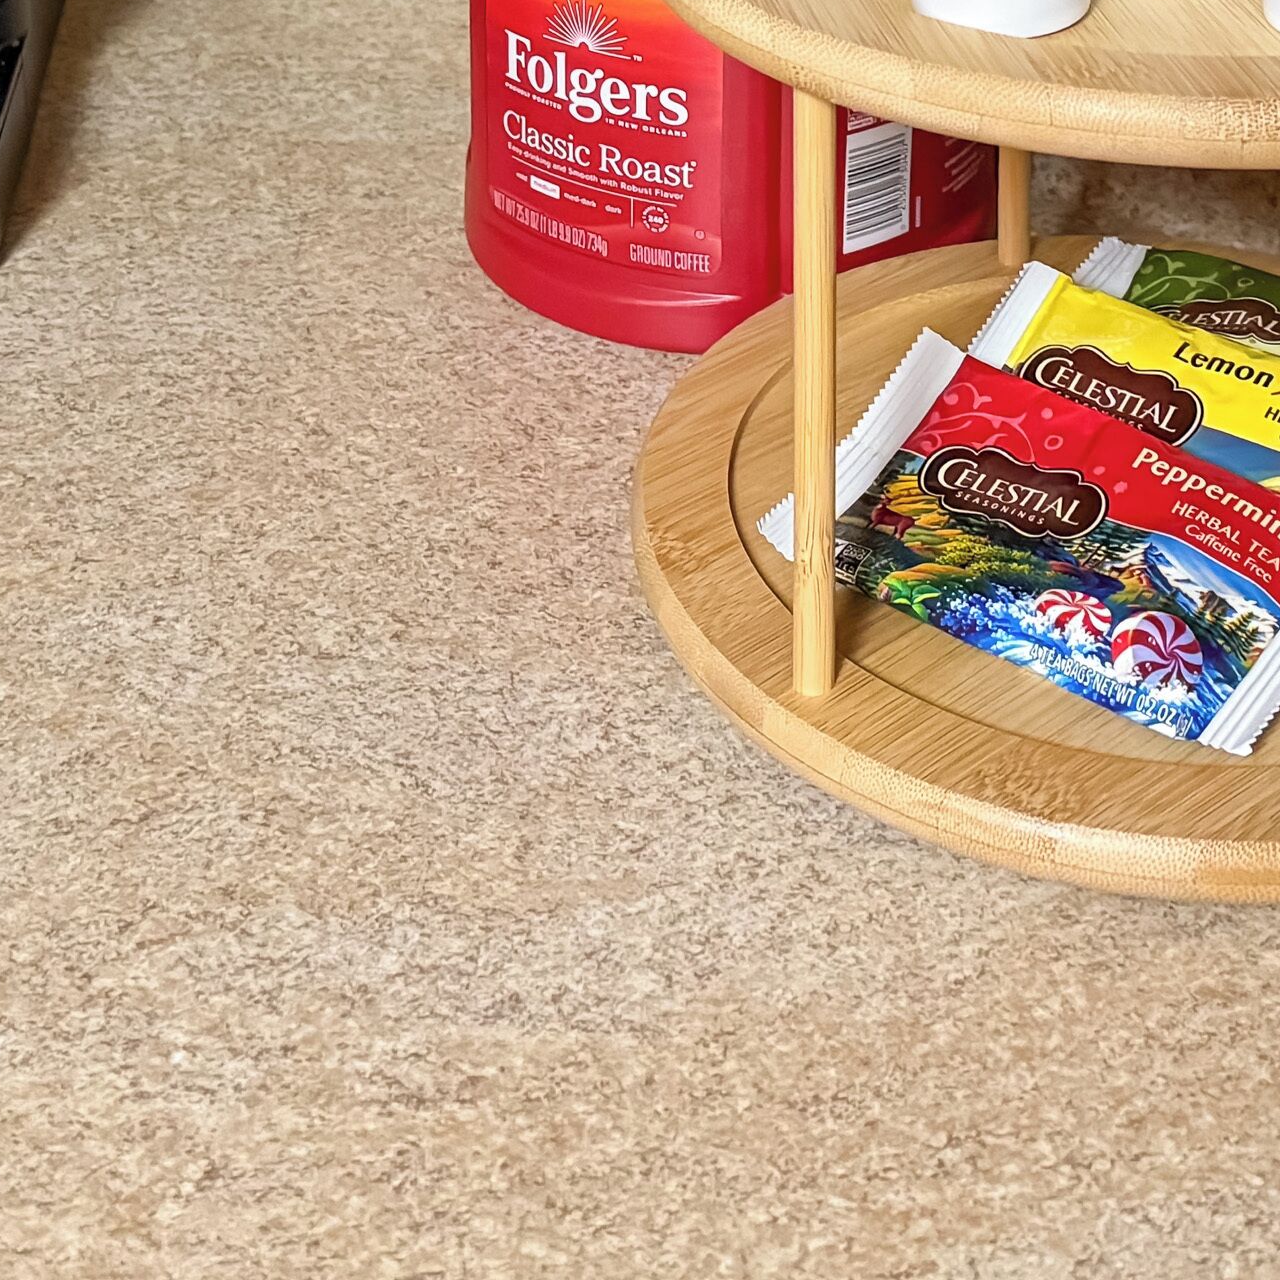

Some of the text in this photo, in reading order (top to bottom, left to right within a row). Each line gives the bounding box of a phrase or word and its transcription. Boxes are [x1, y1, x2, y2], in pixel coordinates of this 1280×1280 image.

[504, 28, 689, 126] Folgers
[503, 109, 694, 189] Classic Roast
[605, 117, 688, 138] IN NEW ORLEANS
[507, 141, 684, 201] Easy drinking and Smooth with Robust Flavor
[604, 204, 622, 215] dark
[629, 243, 711, 273] GROUND COFFEE
[1035, 356, 1179, 433] CELESTIAL
[1172, 341, 1277, 388] Lemon
[937, 458, 1081, 526] CELESTIAL
[955, 490, 1046, 526] SEASONINGS
[1171, 500, 1241, 546] HERBAL
[1184, 523, 1273, 584] Caffeine Free
[1029, 643, 1178, 727] 4 TEA BAGS NET WT 0.2 OZ
